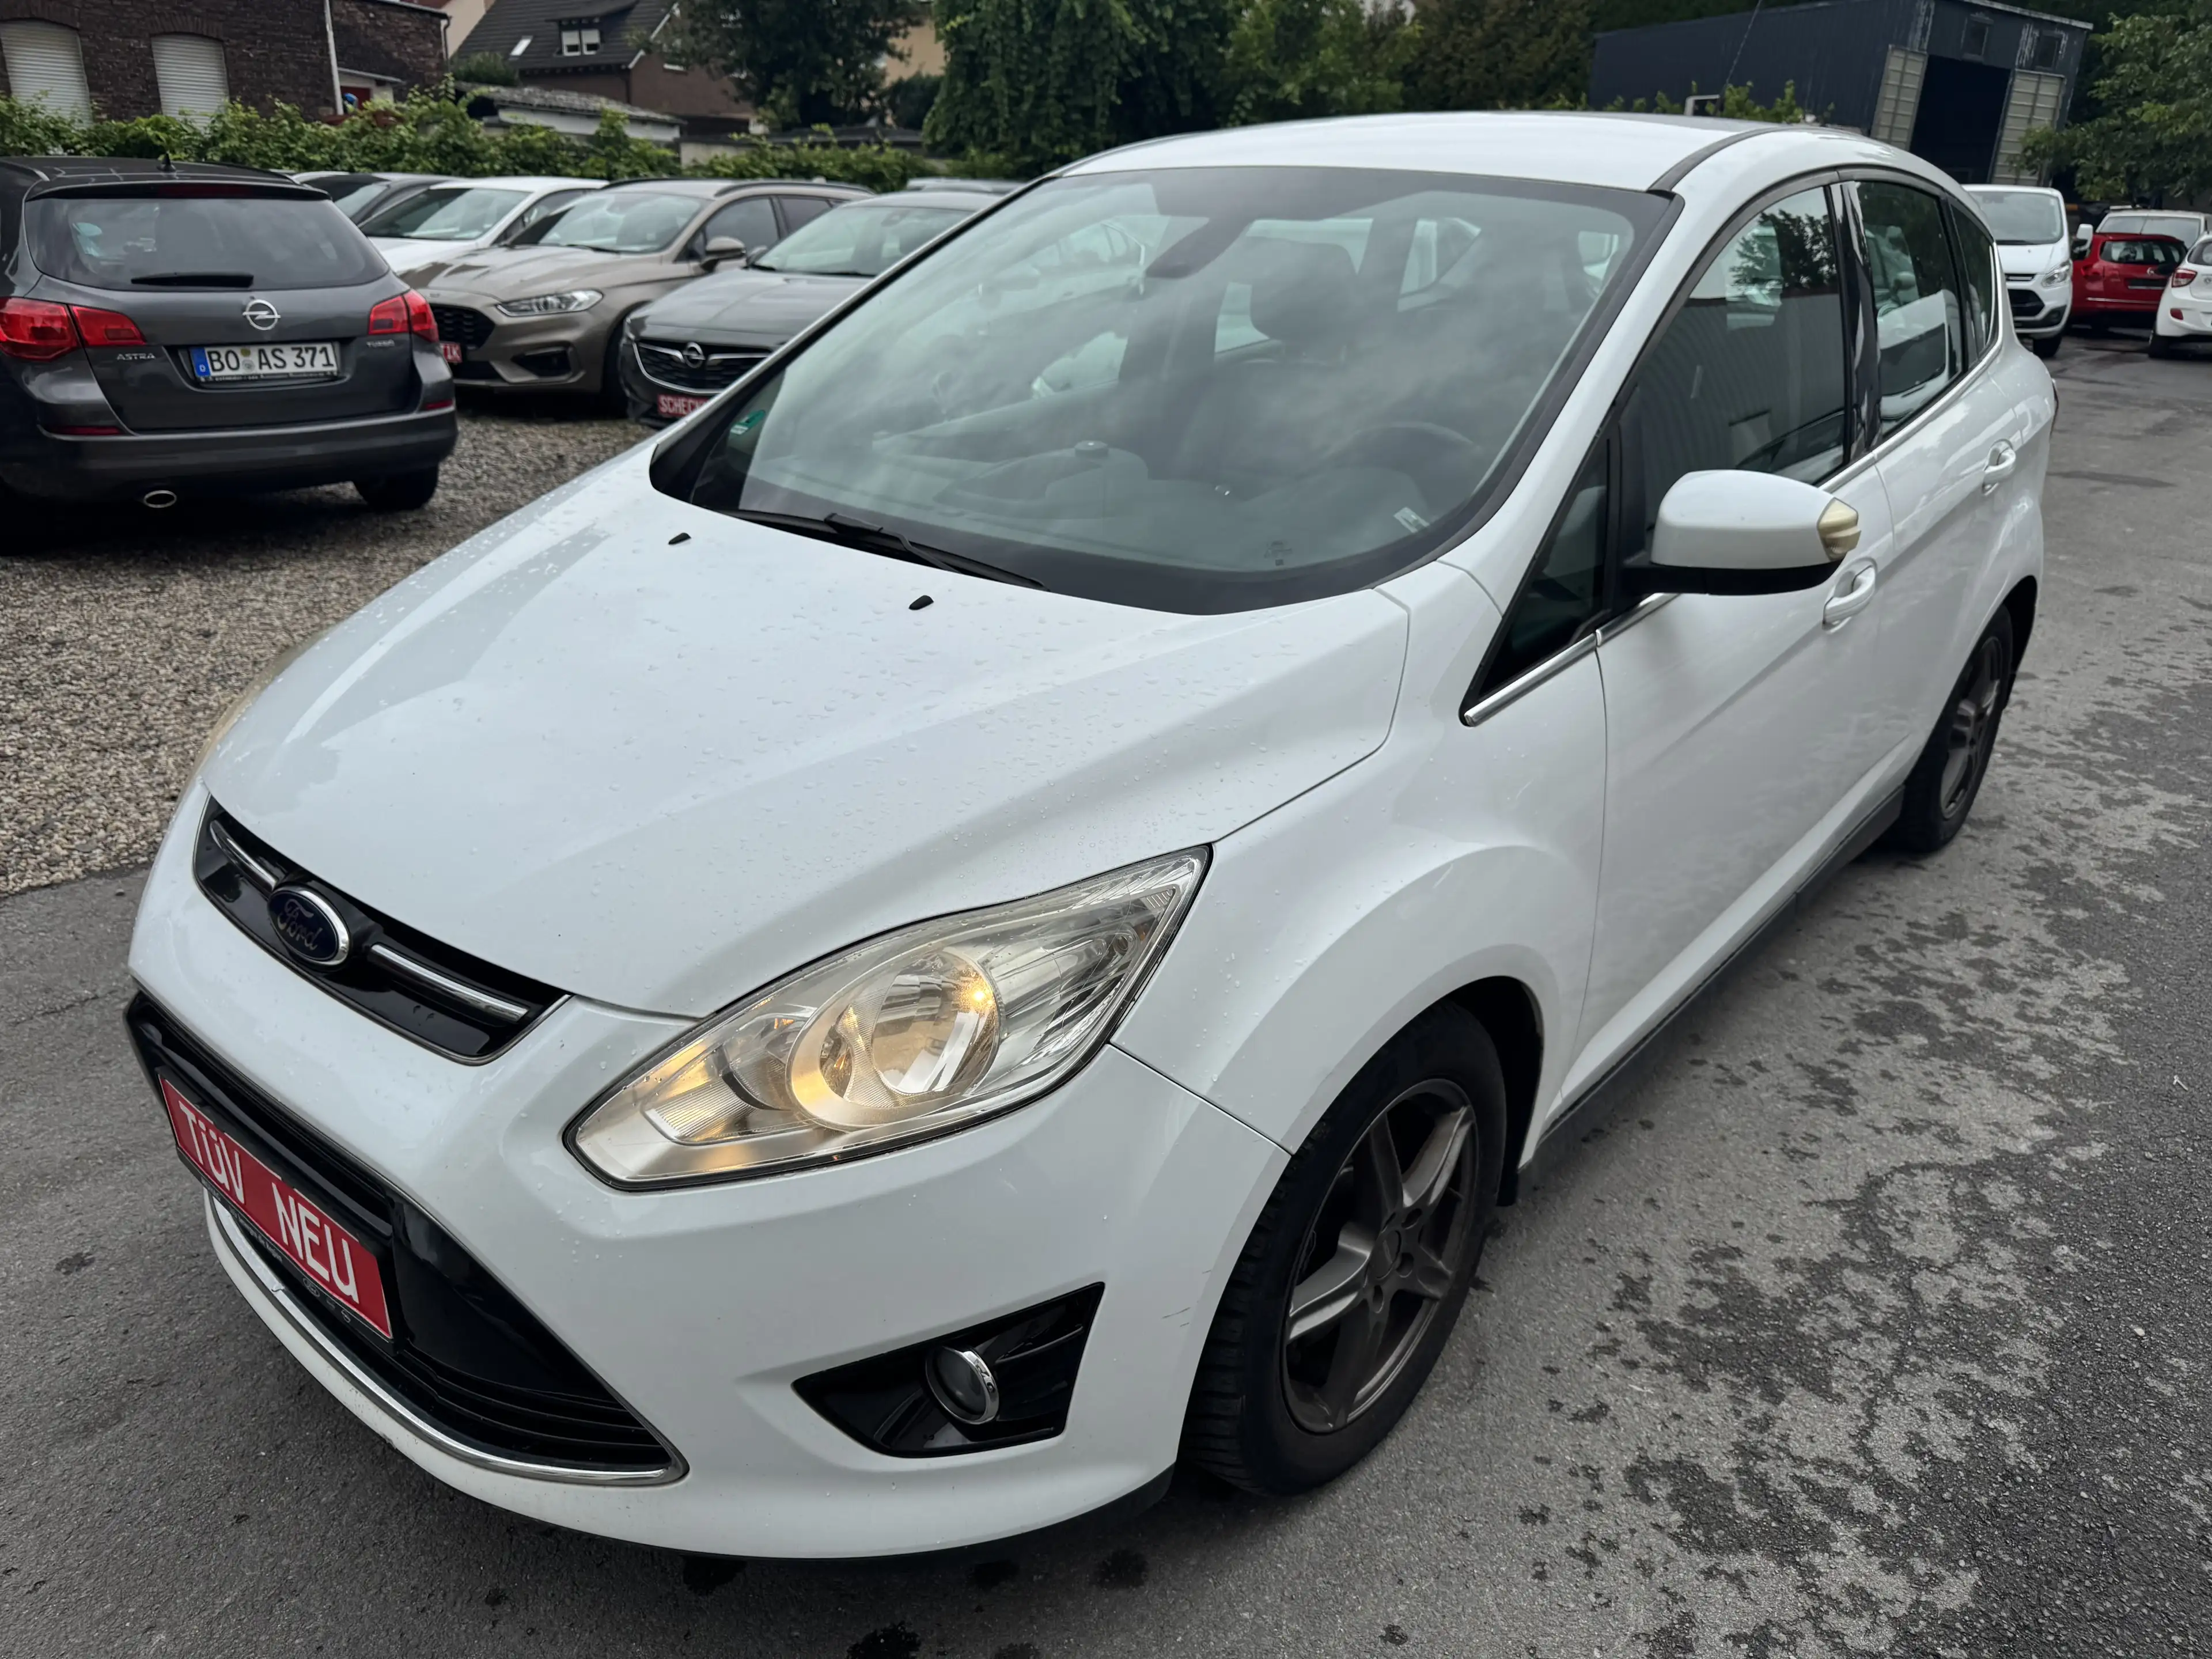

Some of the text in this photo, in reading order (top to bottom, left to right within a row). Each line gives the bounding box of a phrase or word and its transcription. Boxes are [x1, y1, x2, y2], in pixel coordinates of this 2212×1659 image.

[116, 353, 156, 361] ASTRA
[206, 346, 335, 372] BO AS 371
[277, 899, 323, 950] Ford
[179, 1100, 245, 1204] TÜV
[272, 1183, 359, 1304] NEU
